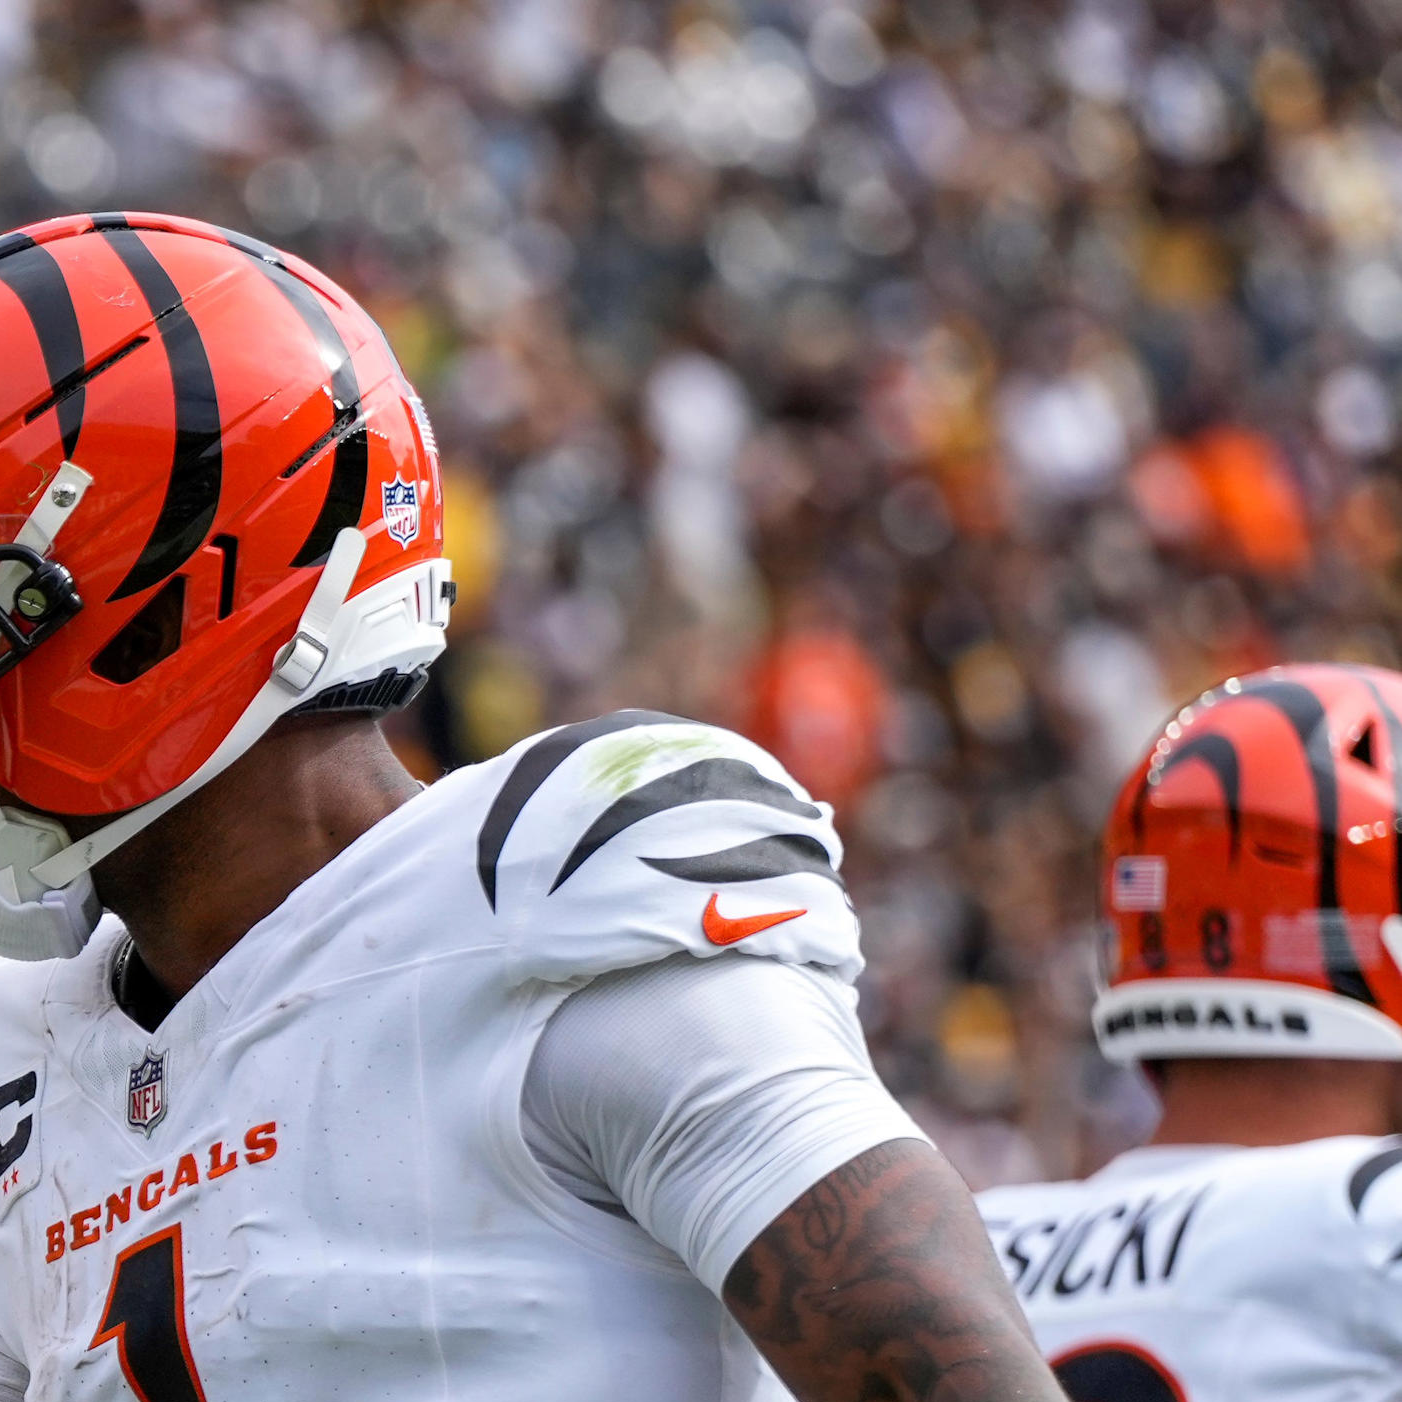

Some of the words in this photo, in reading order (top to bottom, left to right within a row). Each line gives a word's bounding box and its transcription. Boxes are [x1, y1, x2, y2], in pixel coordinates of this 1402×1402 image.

[131, 1084, 161, 1121] NFL
[45, 1121, 278, 1264] BENGALS
[986, 1182, 1214, 1297] SICKI
